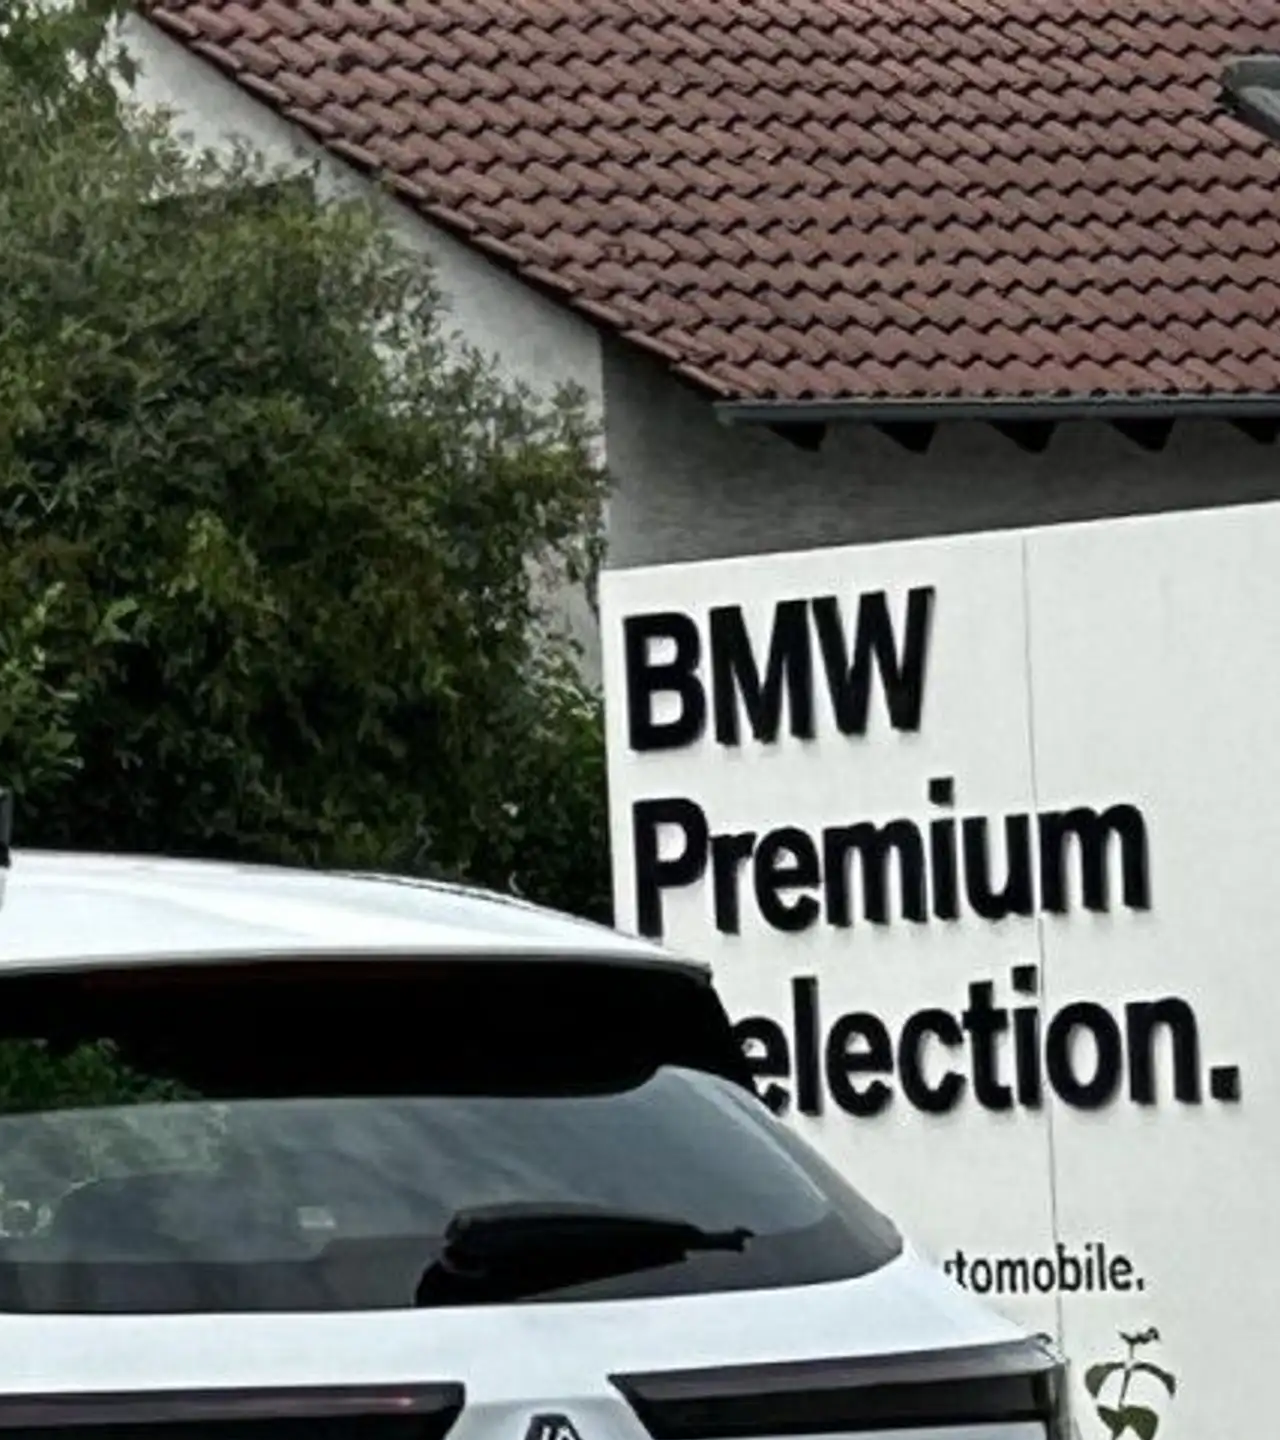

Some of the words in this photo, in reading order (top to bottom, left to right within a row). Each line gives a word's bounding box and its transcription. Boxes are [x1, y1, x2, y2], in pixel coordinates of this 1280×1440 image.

[623, 586, 936, 753] BMW
[631, 777, 1152, 938] Premium
[730, 965, 1241, 1118] election.
[943, 1242, 1146, 1294] tomobile.
